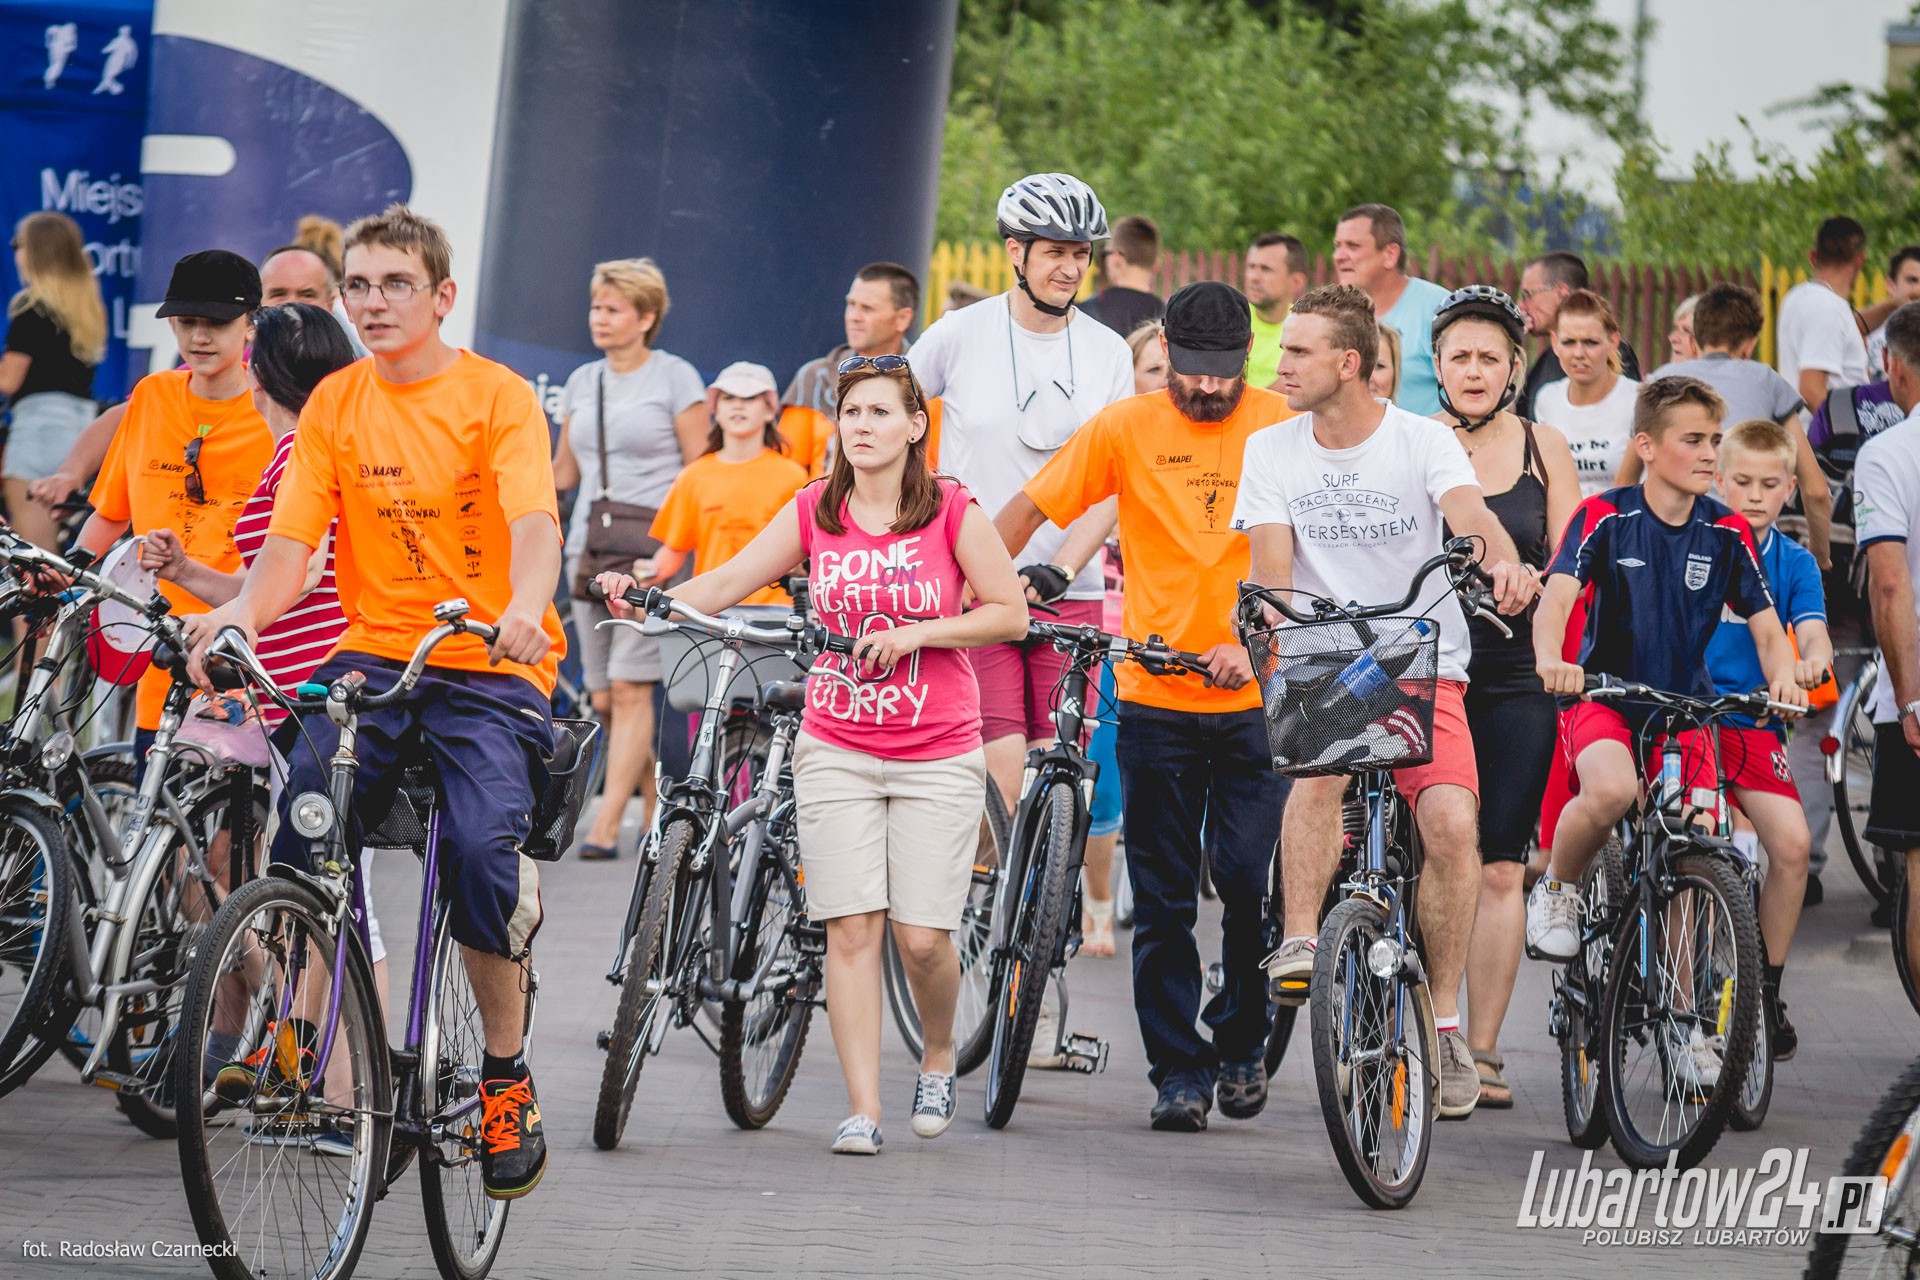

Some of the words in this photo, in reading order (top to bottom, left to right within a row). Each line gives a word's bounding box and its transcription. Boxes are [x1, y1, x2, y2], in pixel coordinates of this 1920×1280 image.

[1168, 455, 1192, 464] MAPEI
[1322, 473, 1359, 488] SURF
[1299, 493, 1343, 509] PACIFIC
[1345, 493, 1388, 508] OCEAN
[818, 536, 924, 584] GONE
[880, 565, 917, 588] ON
